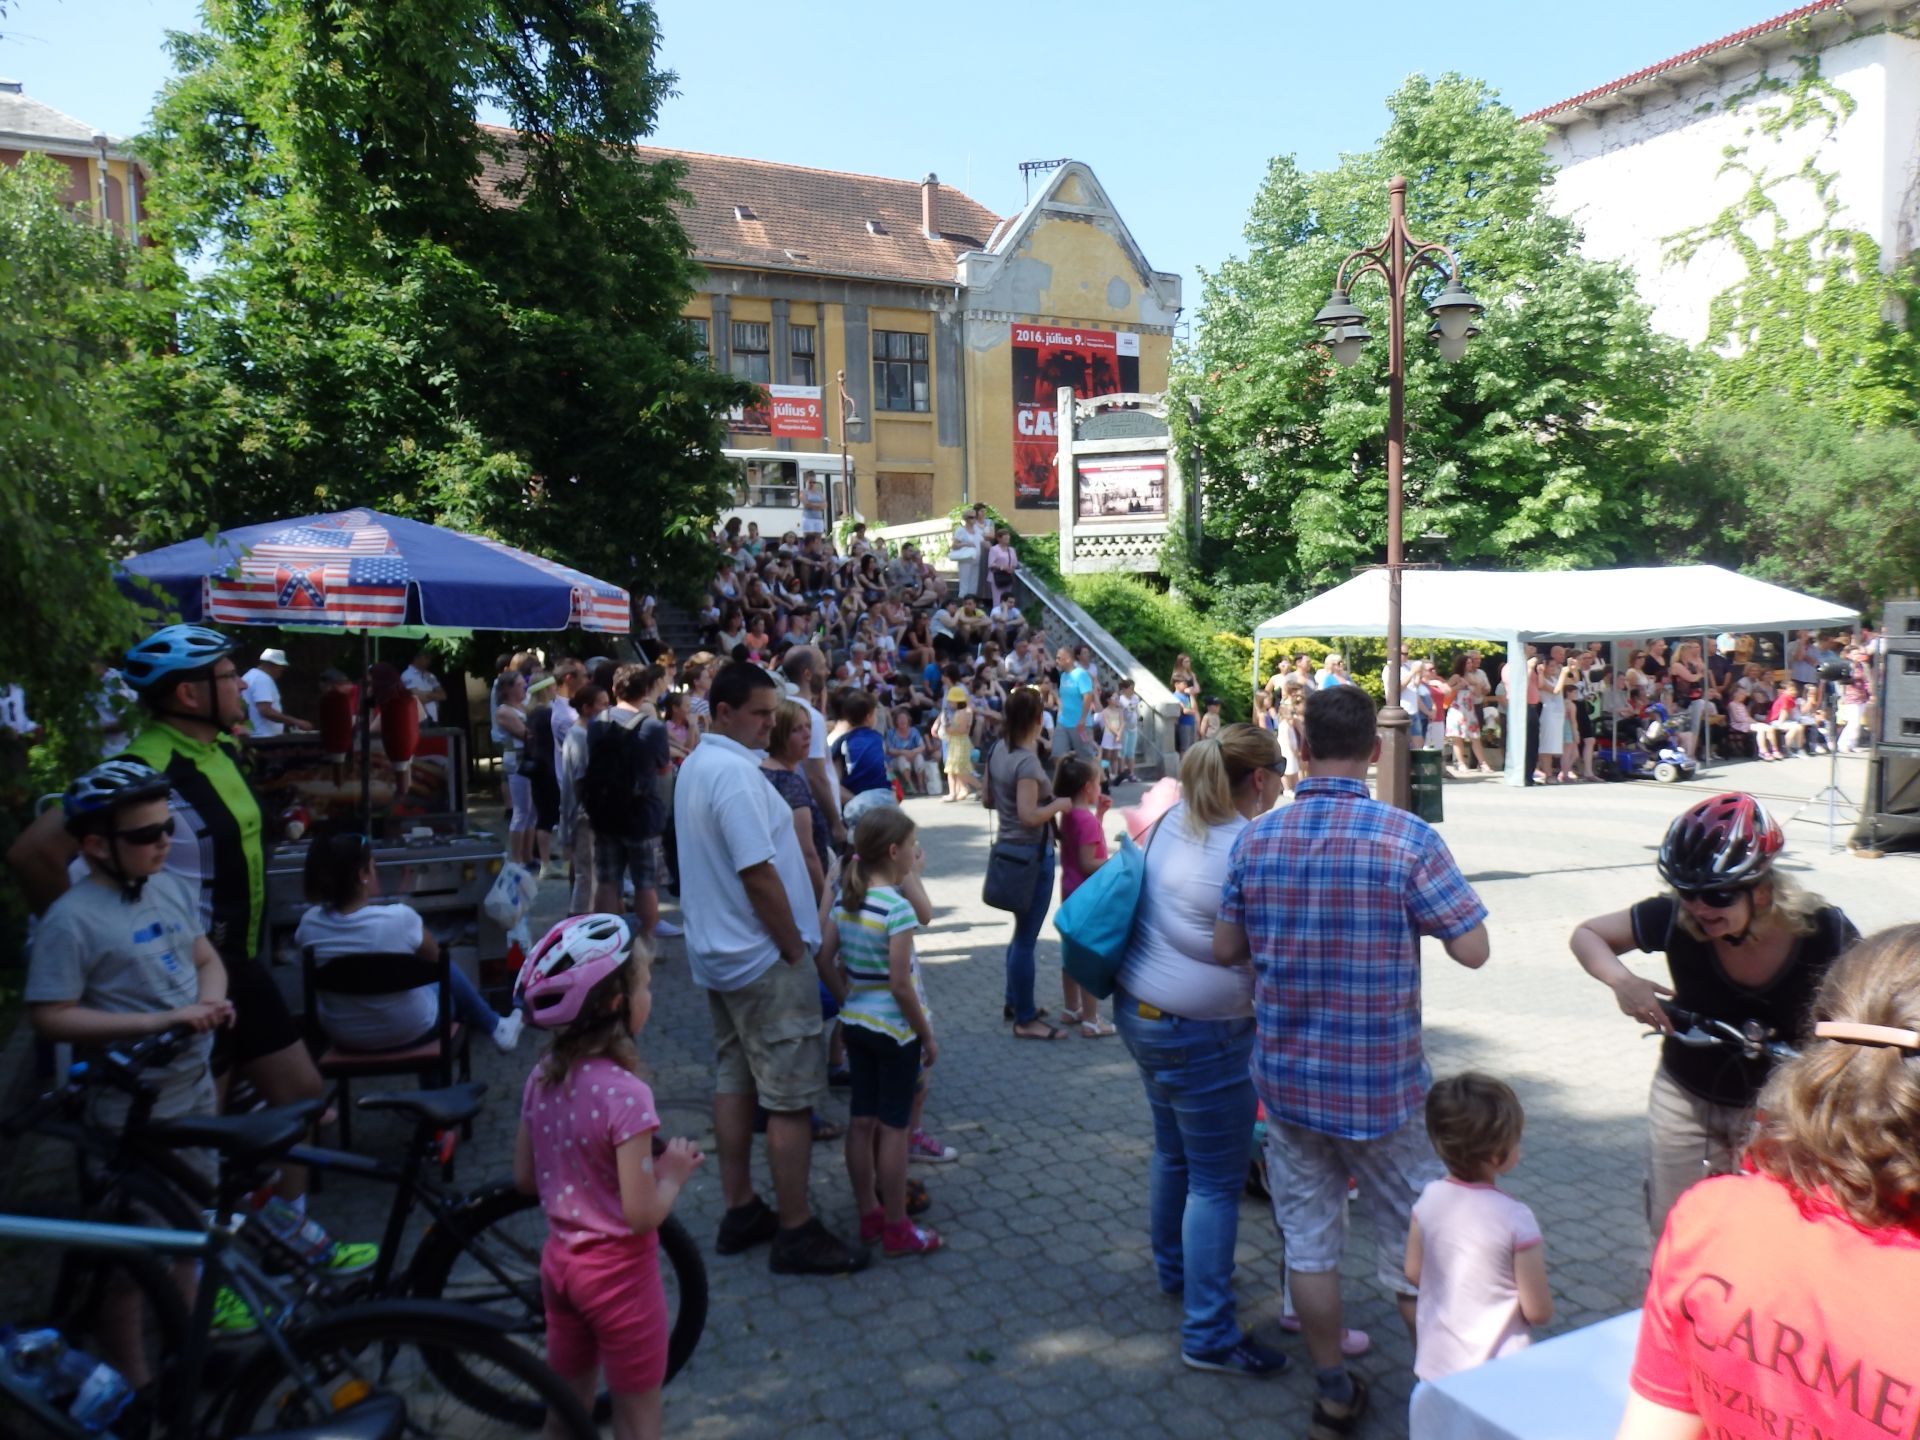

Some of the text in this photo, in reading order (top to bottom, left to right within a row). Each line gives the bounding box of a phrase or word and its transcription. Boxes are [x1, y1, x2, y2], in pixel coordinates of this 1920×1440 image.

[1016, 329, 1045, 343] 2016.
[1045, 332, 1073, 346] július
[1074, 334, 1085, 346] 9.
[773, 402, 820, 418] július 9.
[1679, 1273, 1920, 1440] CARME
